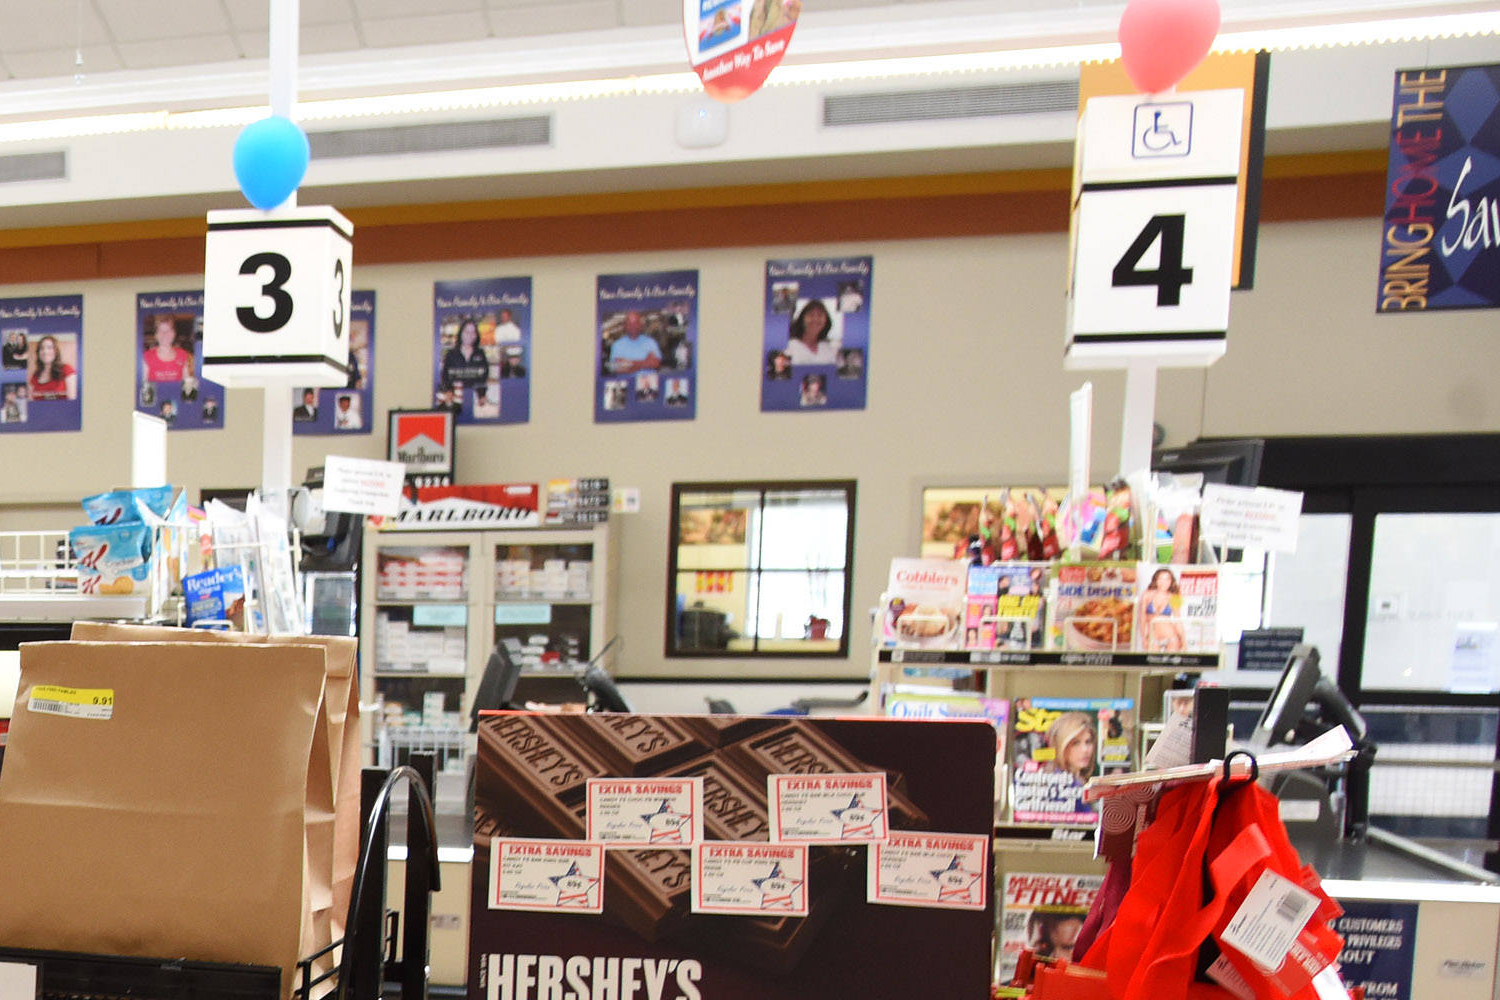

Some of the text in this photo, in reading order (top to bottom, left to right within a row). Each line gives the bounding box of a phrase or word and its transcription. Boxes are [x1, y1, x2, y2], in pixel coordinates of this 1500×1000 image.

[734, 52, 751, 70] Way
[752, 45, 765, 62] To
[1381, 69, 1447, 311] BRING HOME THE
[1111, 212, 1193, 307] 4
[235, 252, 294, 333] 3
[332, 258, 344, 339] 3
[398, 447, 444, 464] Marlboro
[396, 507, 531, 523] MARLBORO
[896, 569, 959, 585] Cobblers
[1058, 585, 1133, 597] SIDE DISHES
[92, 696, 113, 705] 9.91
[1015, 707, 1063, 733] Sta
[599, 785, 682, 794] EXTRA SAVINGS
[786, 780, 872, 789] EXTRA SAVINGS
[1051, 828, 1087, 841] Star
[508, 846, 592, 857] EXTRA SAVINGS
[887, 838, 974, 850] EXTRA SAVINGS
[709, 847, 794, 858] EXTRA SAVINGS
[1008, 876, 1076, 889] MUSCLE
[1014, 888, 1098, 906] FITNES
[1338, 918, 1404, 935] CUSTOMERS
[1347, 934, 1402, 950] PRIVILEGES
